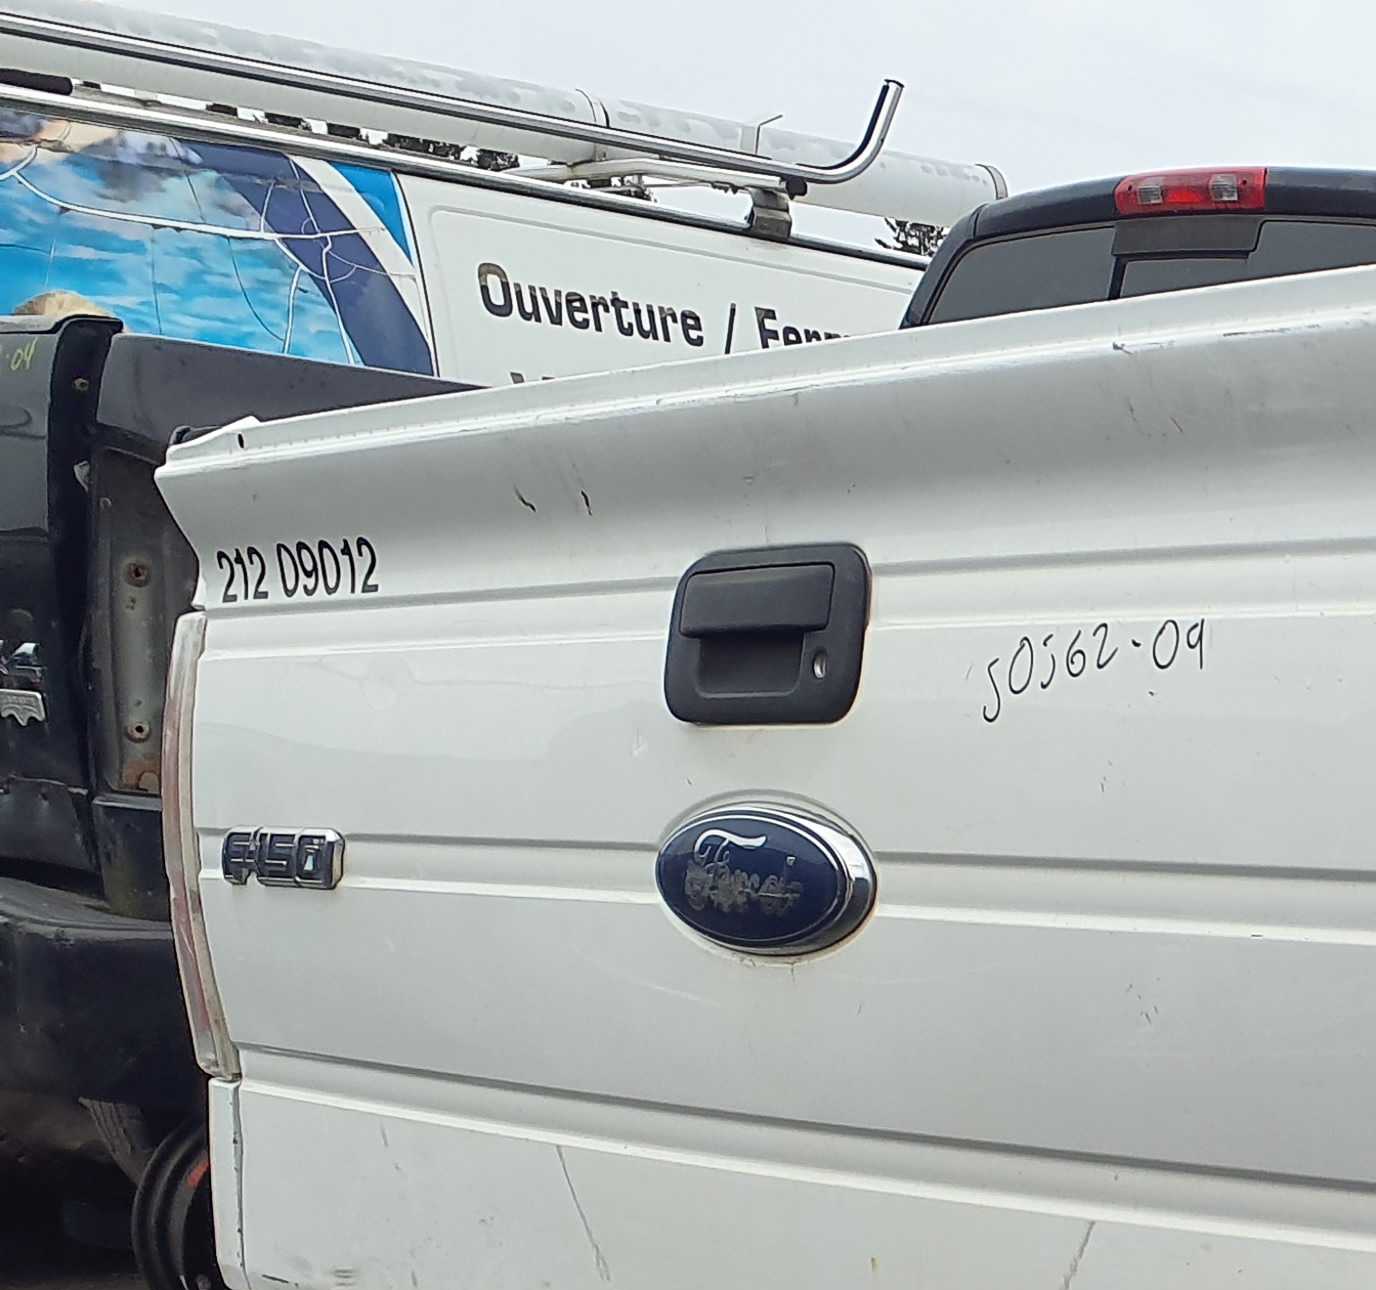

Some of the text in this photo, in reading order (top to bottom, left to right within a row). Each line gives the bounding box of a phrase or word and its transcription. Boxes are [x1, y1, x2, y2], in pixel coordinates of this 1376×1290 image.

[477, 262, 704, 347] Ouverture
[216, 536, 379, 603] 212 09012
